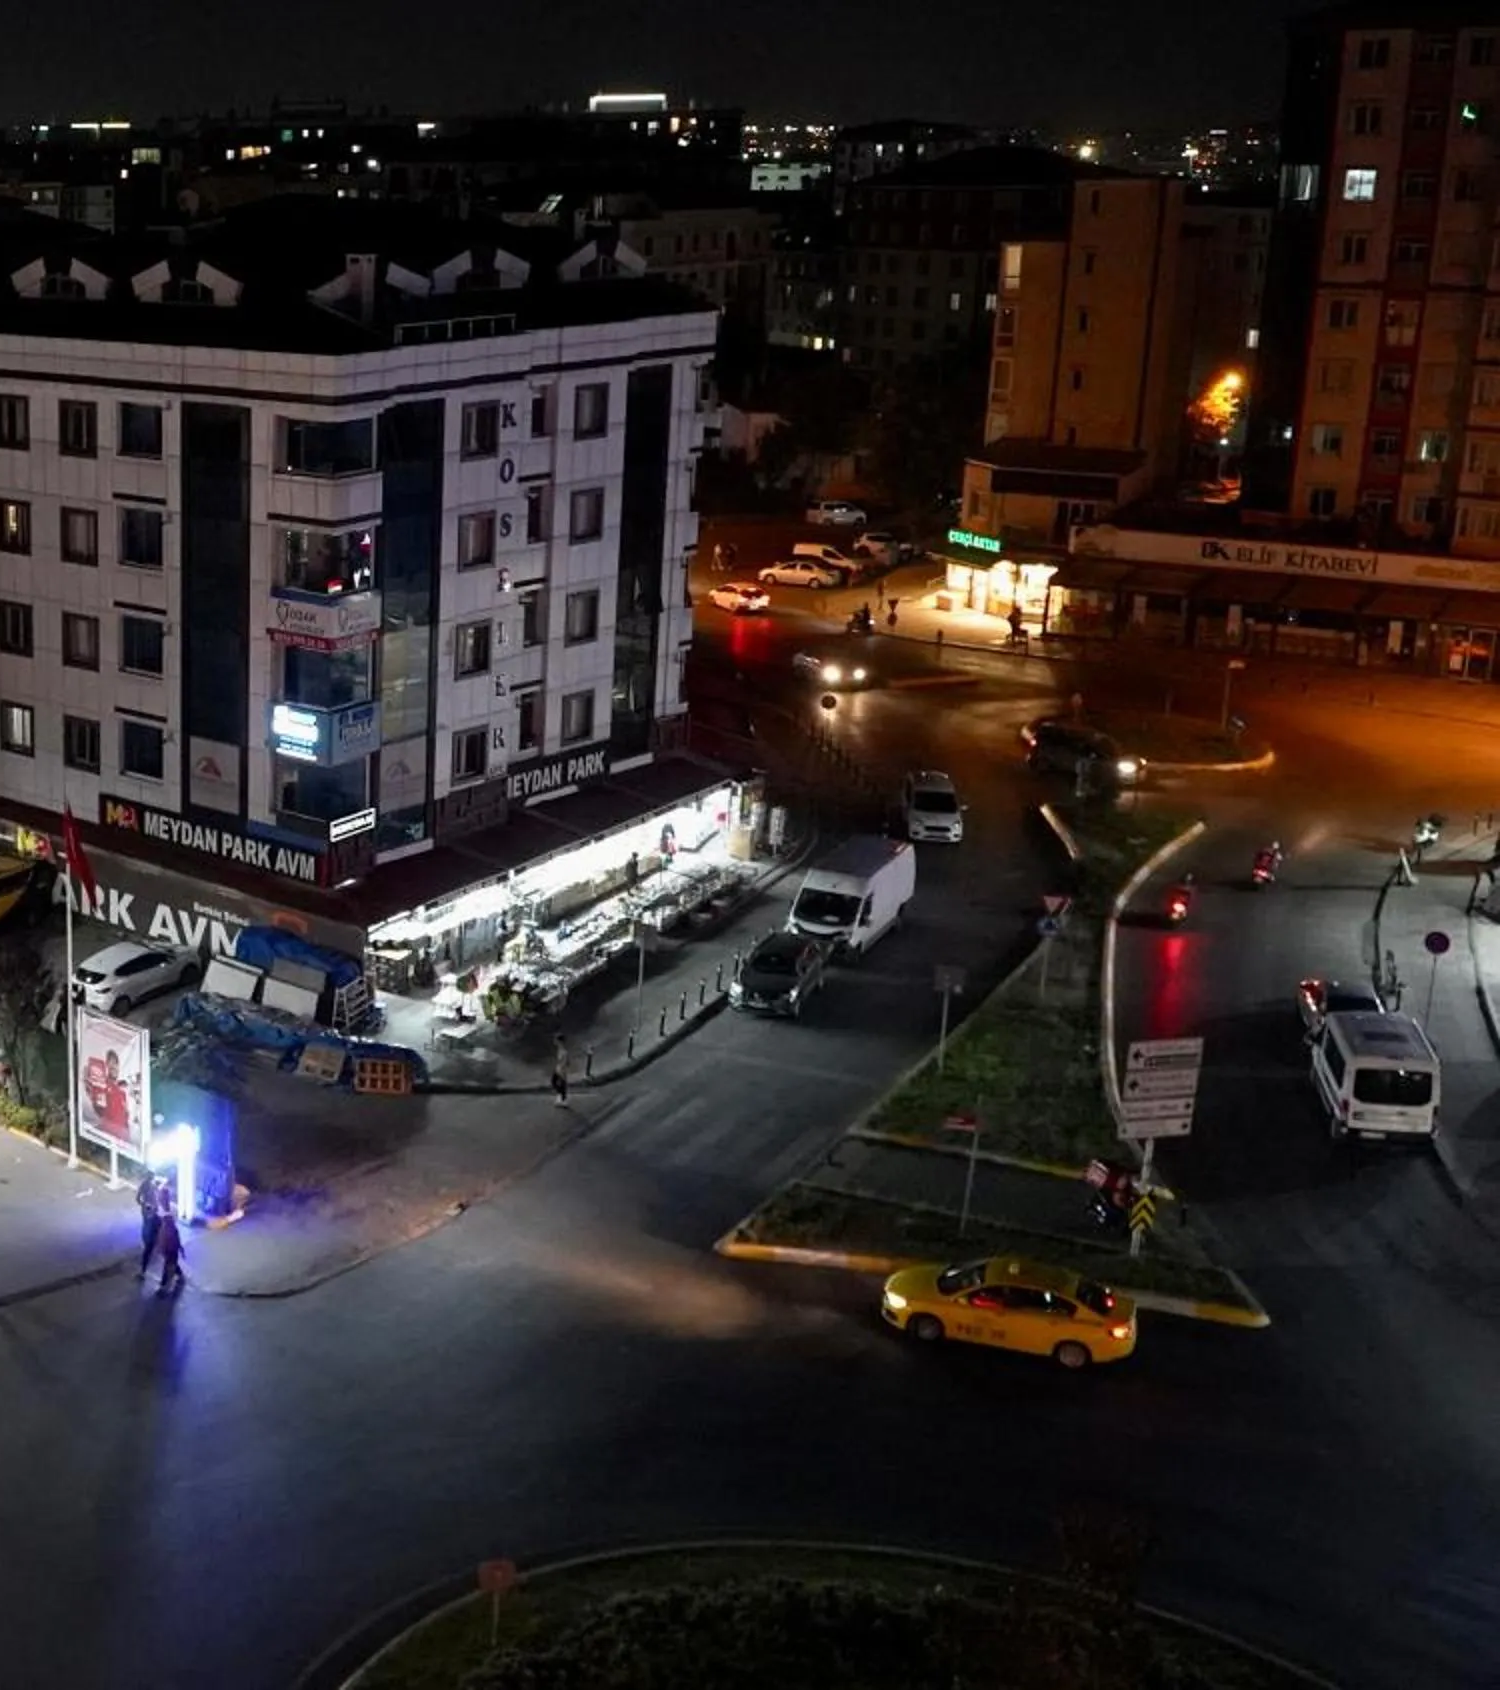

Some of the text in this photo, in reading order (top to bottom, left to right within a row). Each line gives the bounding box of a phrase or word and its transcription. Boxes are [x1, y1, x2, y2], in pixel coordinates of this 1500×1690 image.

[567, 751, 605, 781] PARK
[144, 811, 218, 855] MEYDAN
[222, 832, 271, 870] PARK
[275, 847, 315, 881] AVM
[52, 872, 135, 931] ARK
[148, 903, 243, 957] AVM
